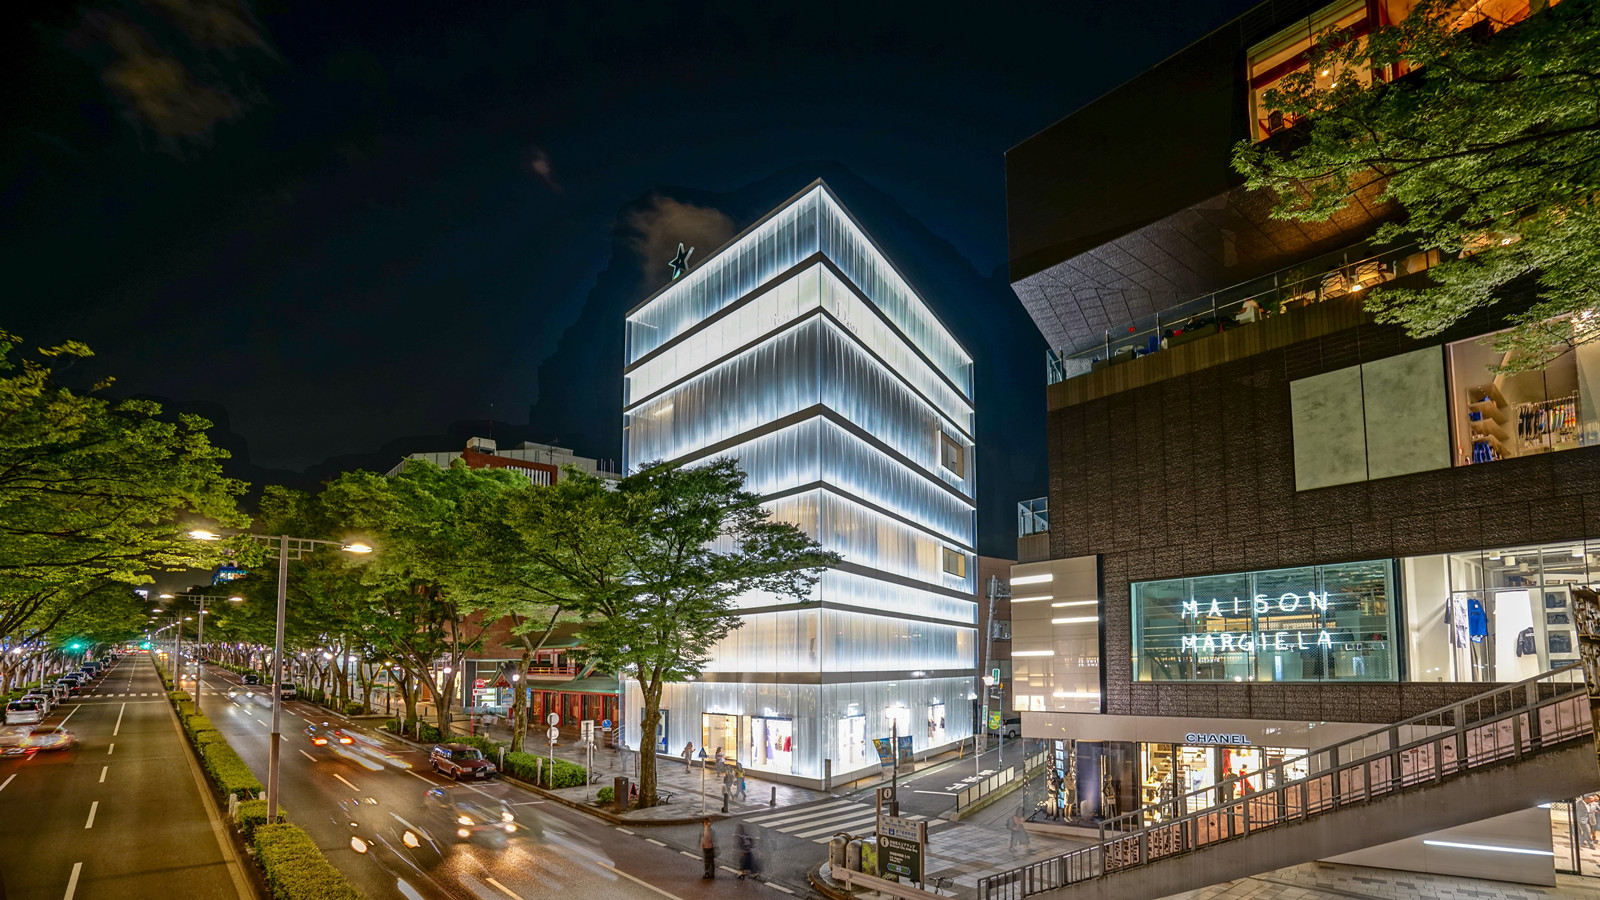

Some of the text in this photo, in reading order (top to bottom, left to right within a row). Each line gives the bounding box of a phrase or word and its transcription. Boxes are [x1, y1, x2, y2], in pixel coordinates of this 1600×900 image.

[1182, 591, 1328, 619] MAISON
[1182, 630, 1332, 653] MARGIELA
[1186, 733, 1251, 745] CHANEL
